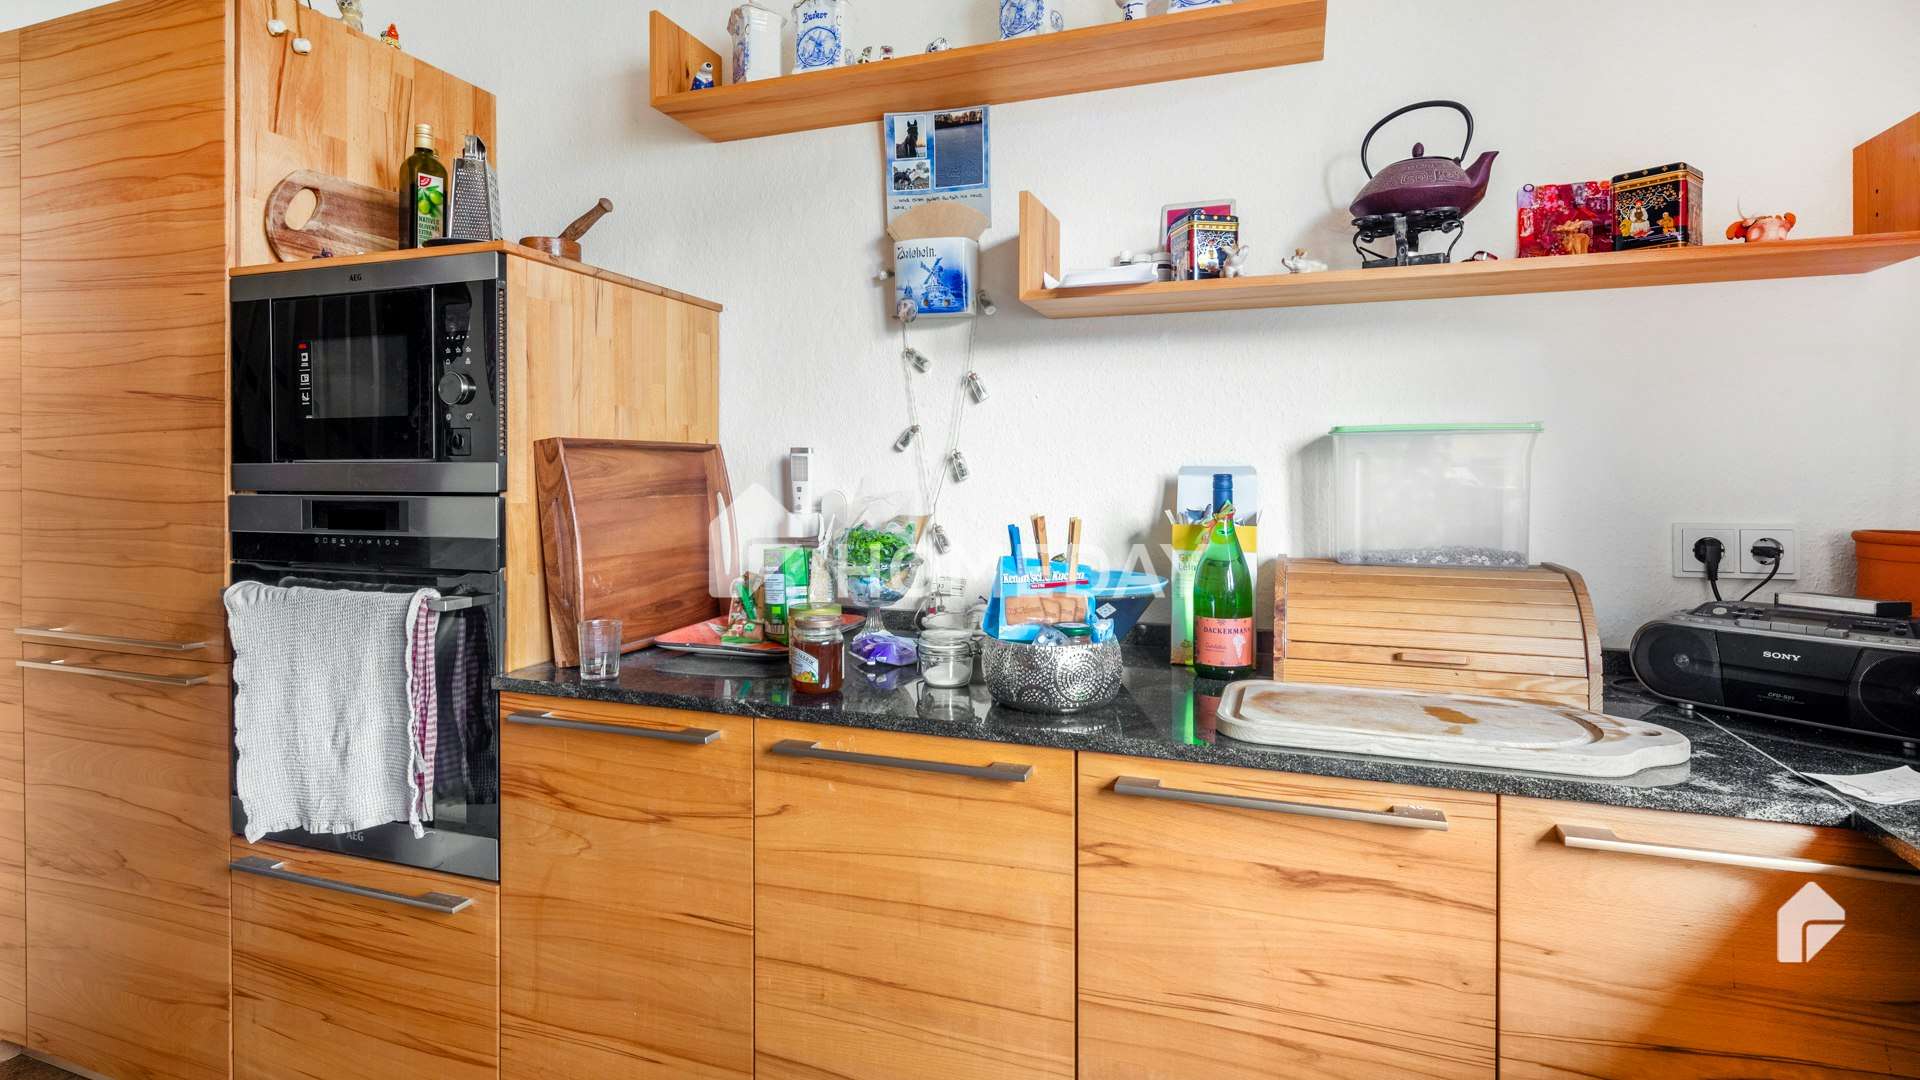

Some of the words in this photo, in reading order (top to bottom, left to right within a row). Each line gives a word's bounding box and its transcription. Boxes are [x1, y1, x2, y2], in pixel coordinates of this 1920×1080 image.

[349, 273, 362, 282] AEG
[1762, 650, 1801, 662] SONY
[346, 831, 364, 842] AEG
